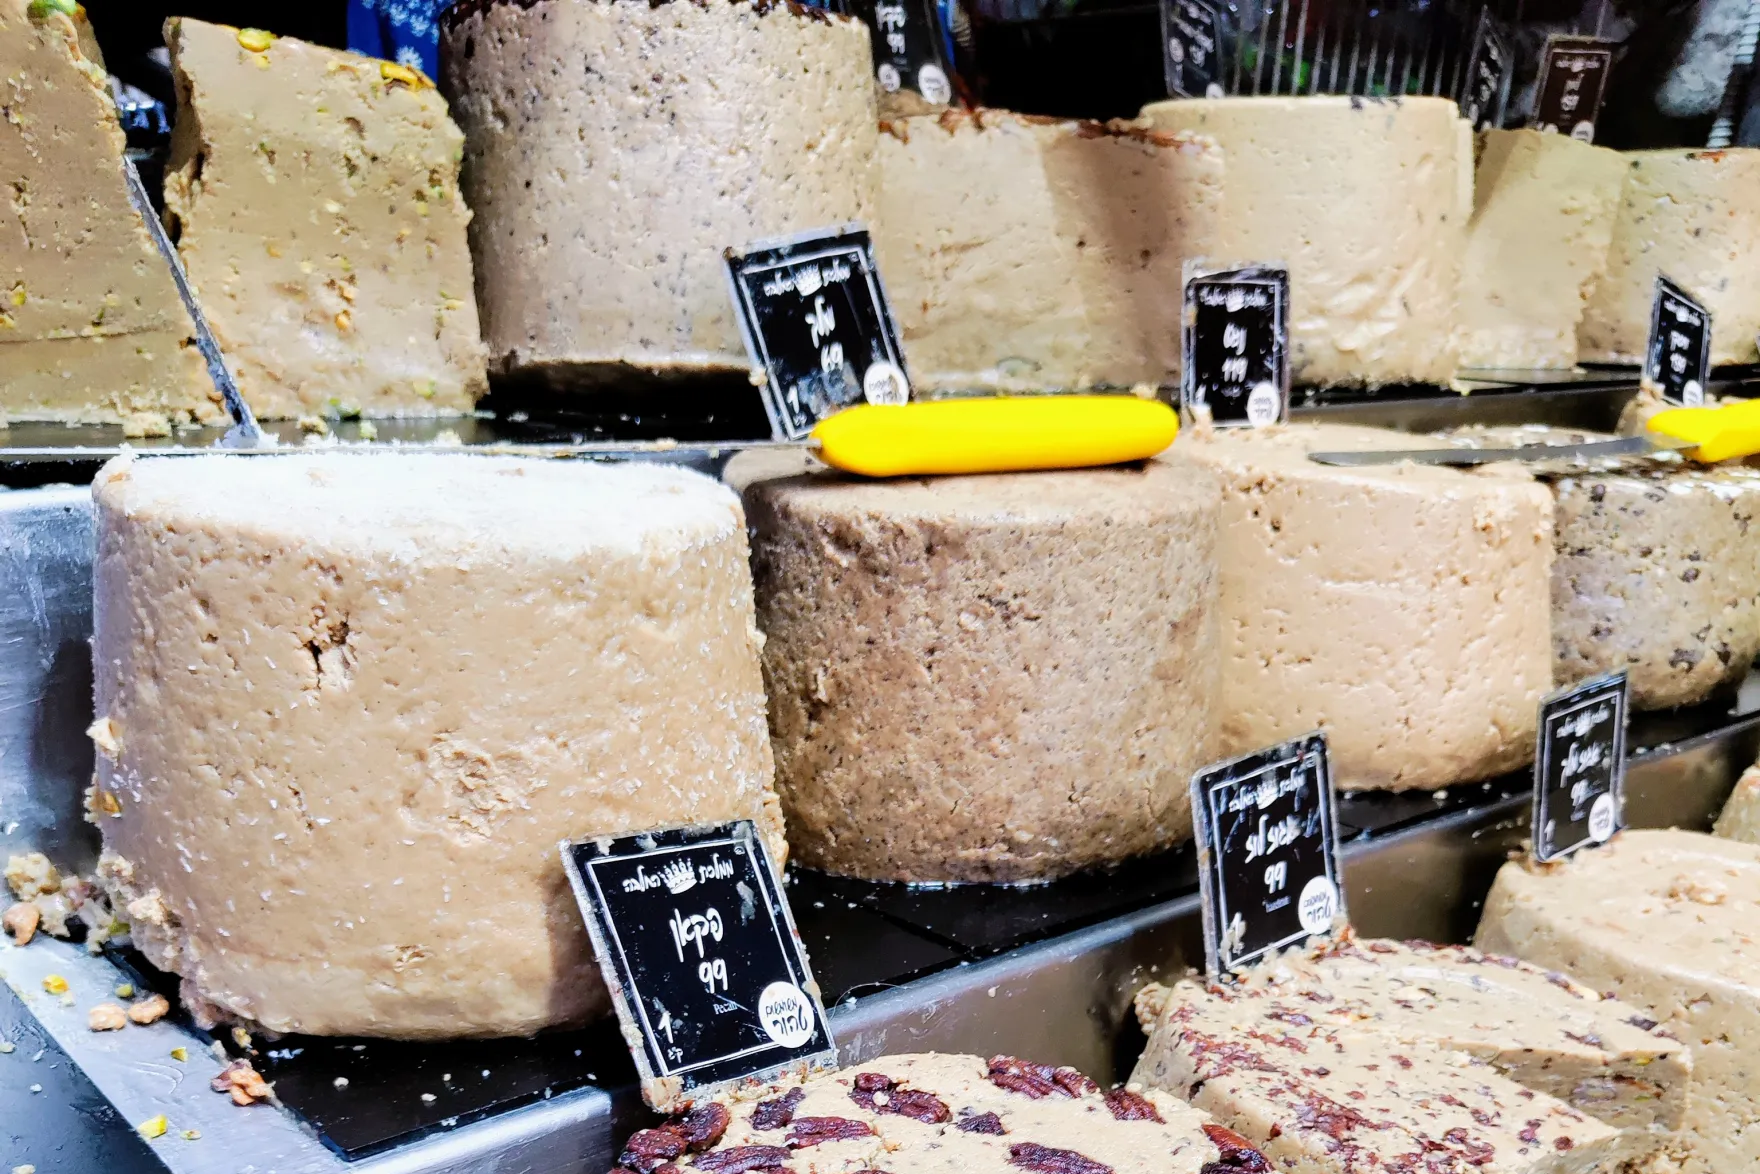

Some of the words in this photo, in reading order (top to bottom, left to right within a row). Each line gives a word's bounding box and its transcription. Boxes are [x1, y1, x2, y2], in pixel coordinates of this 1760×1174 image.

[1264, 861, 1288, 894] 99
[669, 907, 724, 963] פקאן
[698, 958, 728, 994] 99
[772, 1004, 808, 1036] טהור
